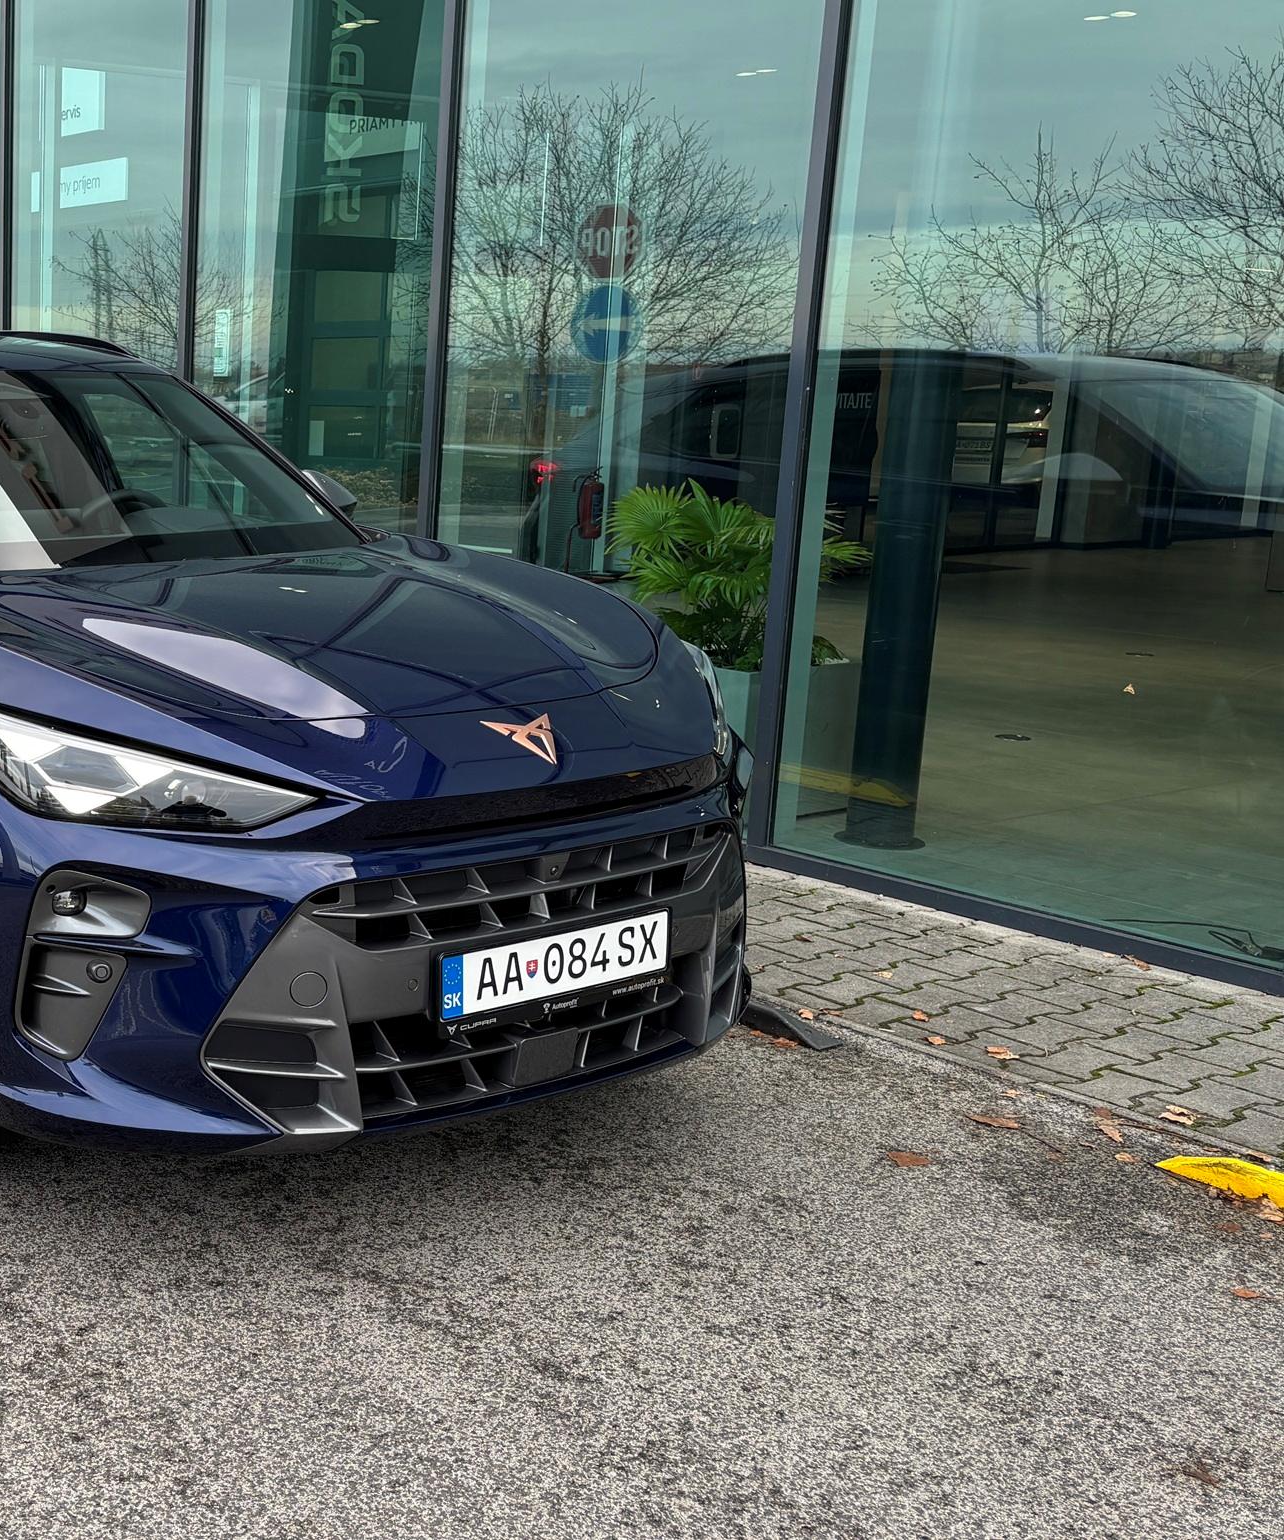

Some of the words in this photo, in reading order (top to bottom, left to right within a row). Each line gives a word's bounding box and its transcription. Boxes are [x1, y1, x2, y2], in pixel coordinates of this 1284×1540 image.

[73, 175, 101, 197] príjem
[476, 951, 523, 1001] AA
[612, 976, 665, 996] www.autoprofit.sk
[443, 991, 462, 1009] SK
[552, 997, 579, 1011] Autoprofit
[459, 1017, 497, 1031] CUPRA
